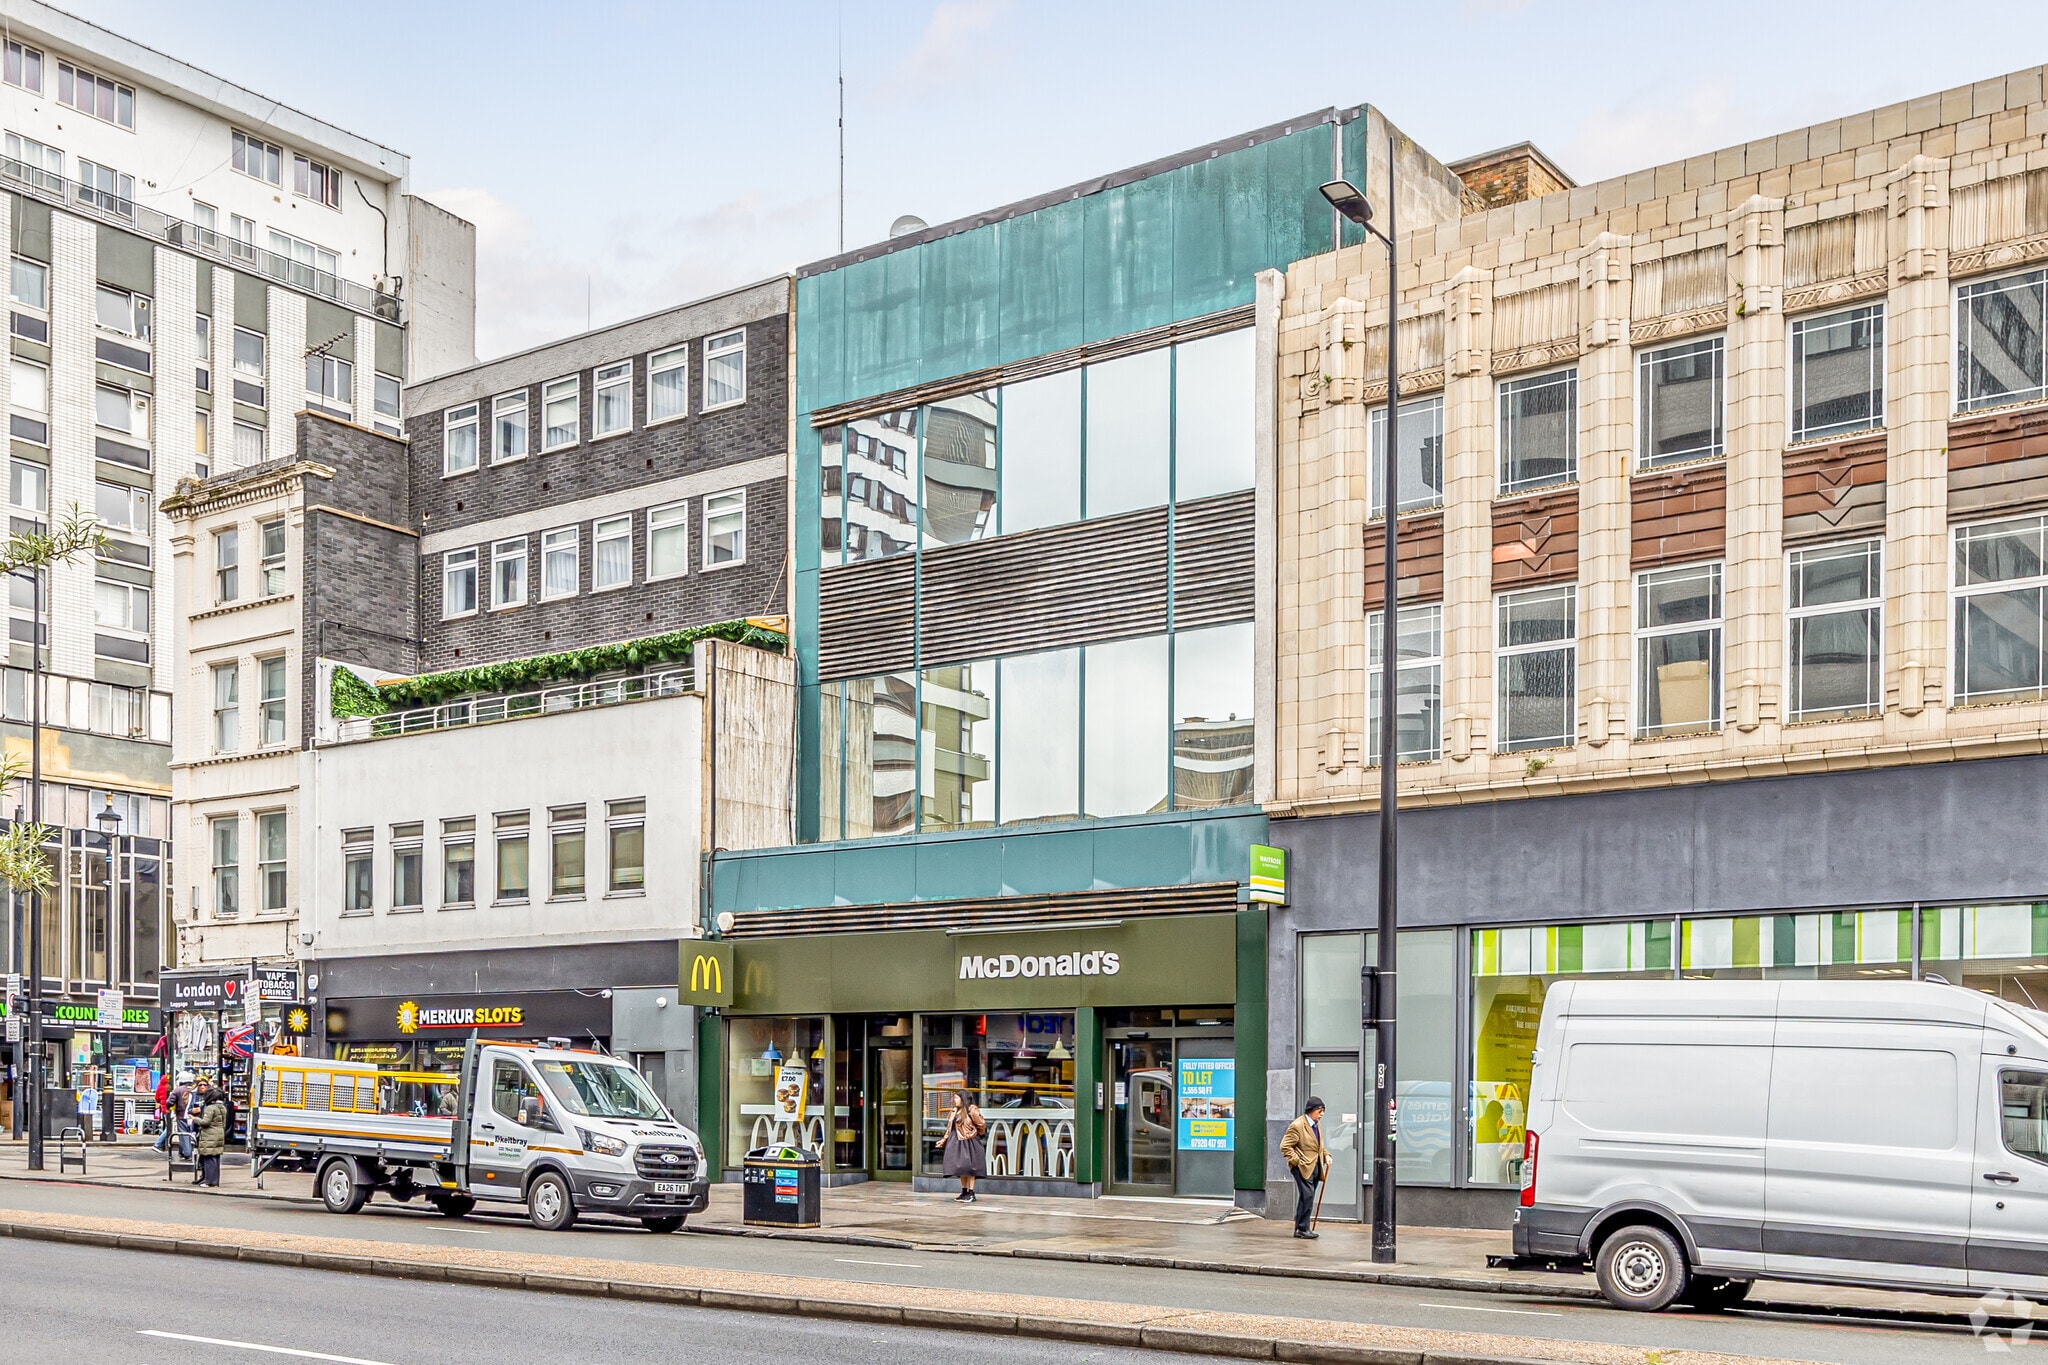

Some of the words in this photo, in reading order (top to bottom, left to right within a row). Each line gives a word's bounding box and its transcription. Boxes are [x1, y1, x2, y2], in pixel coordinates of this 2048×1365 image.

[959, 950, 1120, 979] McDonald's
[266, 971, 287, 981] VAPE
[175, 981, 221, 998] London
[259, 980, 295, 990] TOBACCO
[418, 1009, 475, 1025] MERKUR
[475, 1006, 522, 1024] SLOTS
[1182, 1062, 1197, 1070] FULLY
[1198, 1062, 1215, 1070] FITTED
[1182, 1071, 1194, 1085] TO
[1195, 1071, 1213, 1085] LET
[1198, 1086, 1206, 1095] SQ
[1206, 1086, 1213, 1094] FT
